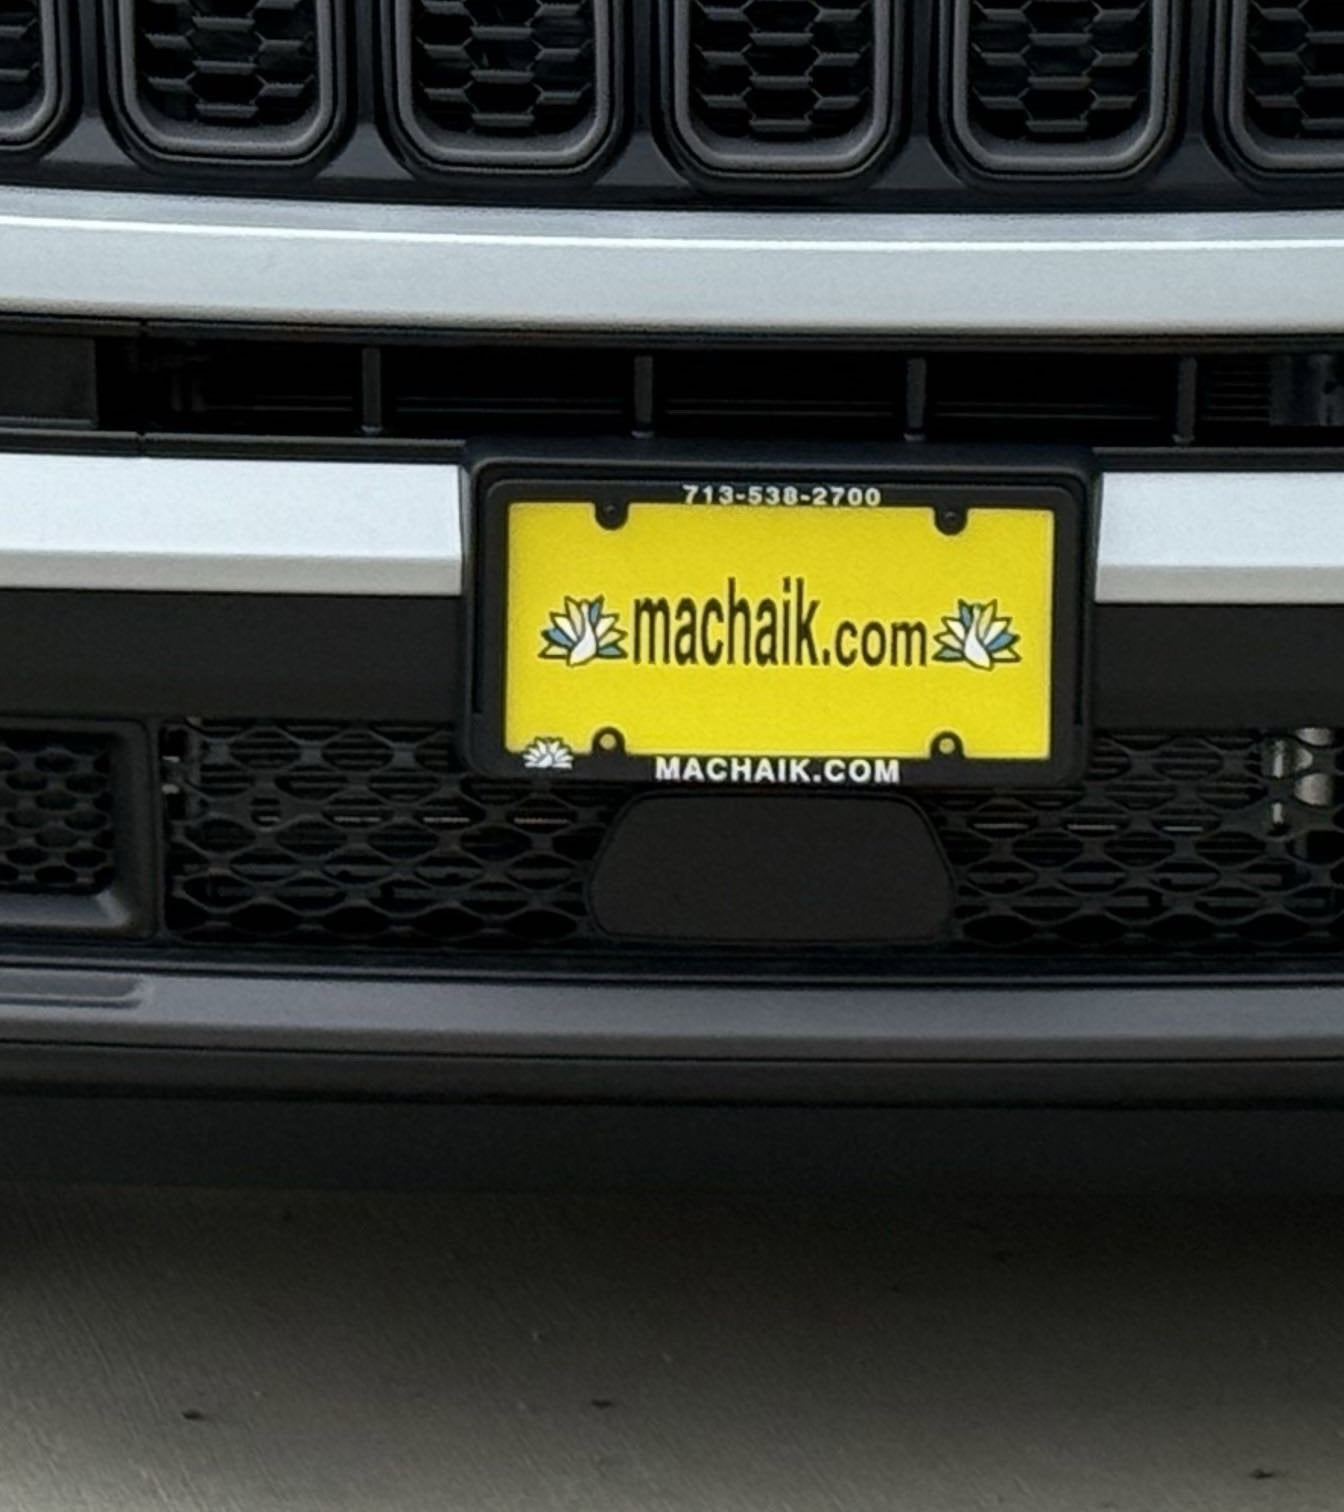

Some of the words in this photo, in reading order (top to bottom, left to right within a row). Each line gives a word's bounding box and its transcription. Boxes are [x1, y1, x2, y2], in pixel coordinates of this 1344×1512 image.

[682, 484, 881, 506] 713-538-2700
[632, 576, 928, 667] machaik.com
[655, 755, 900, 784] MACHAIK.COM
